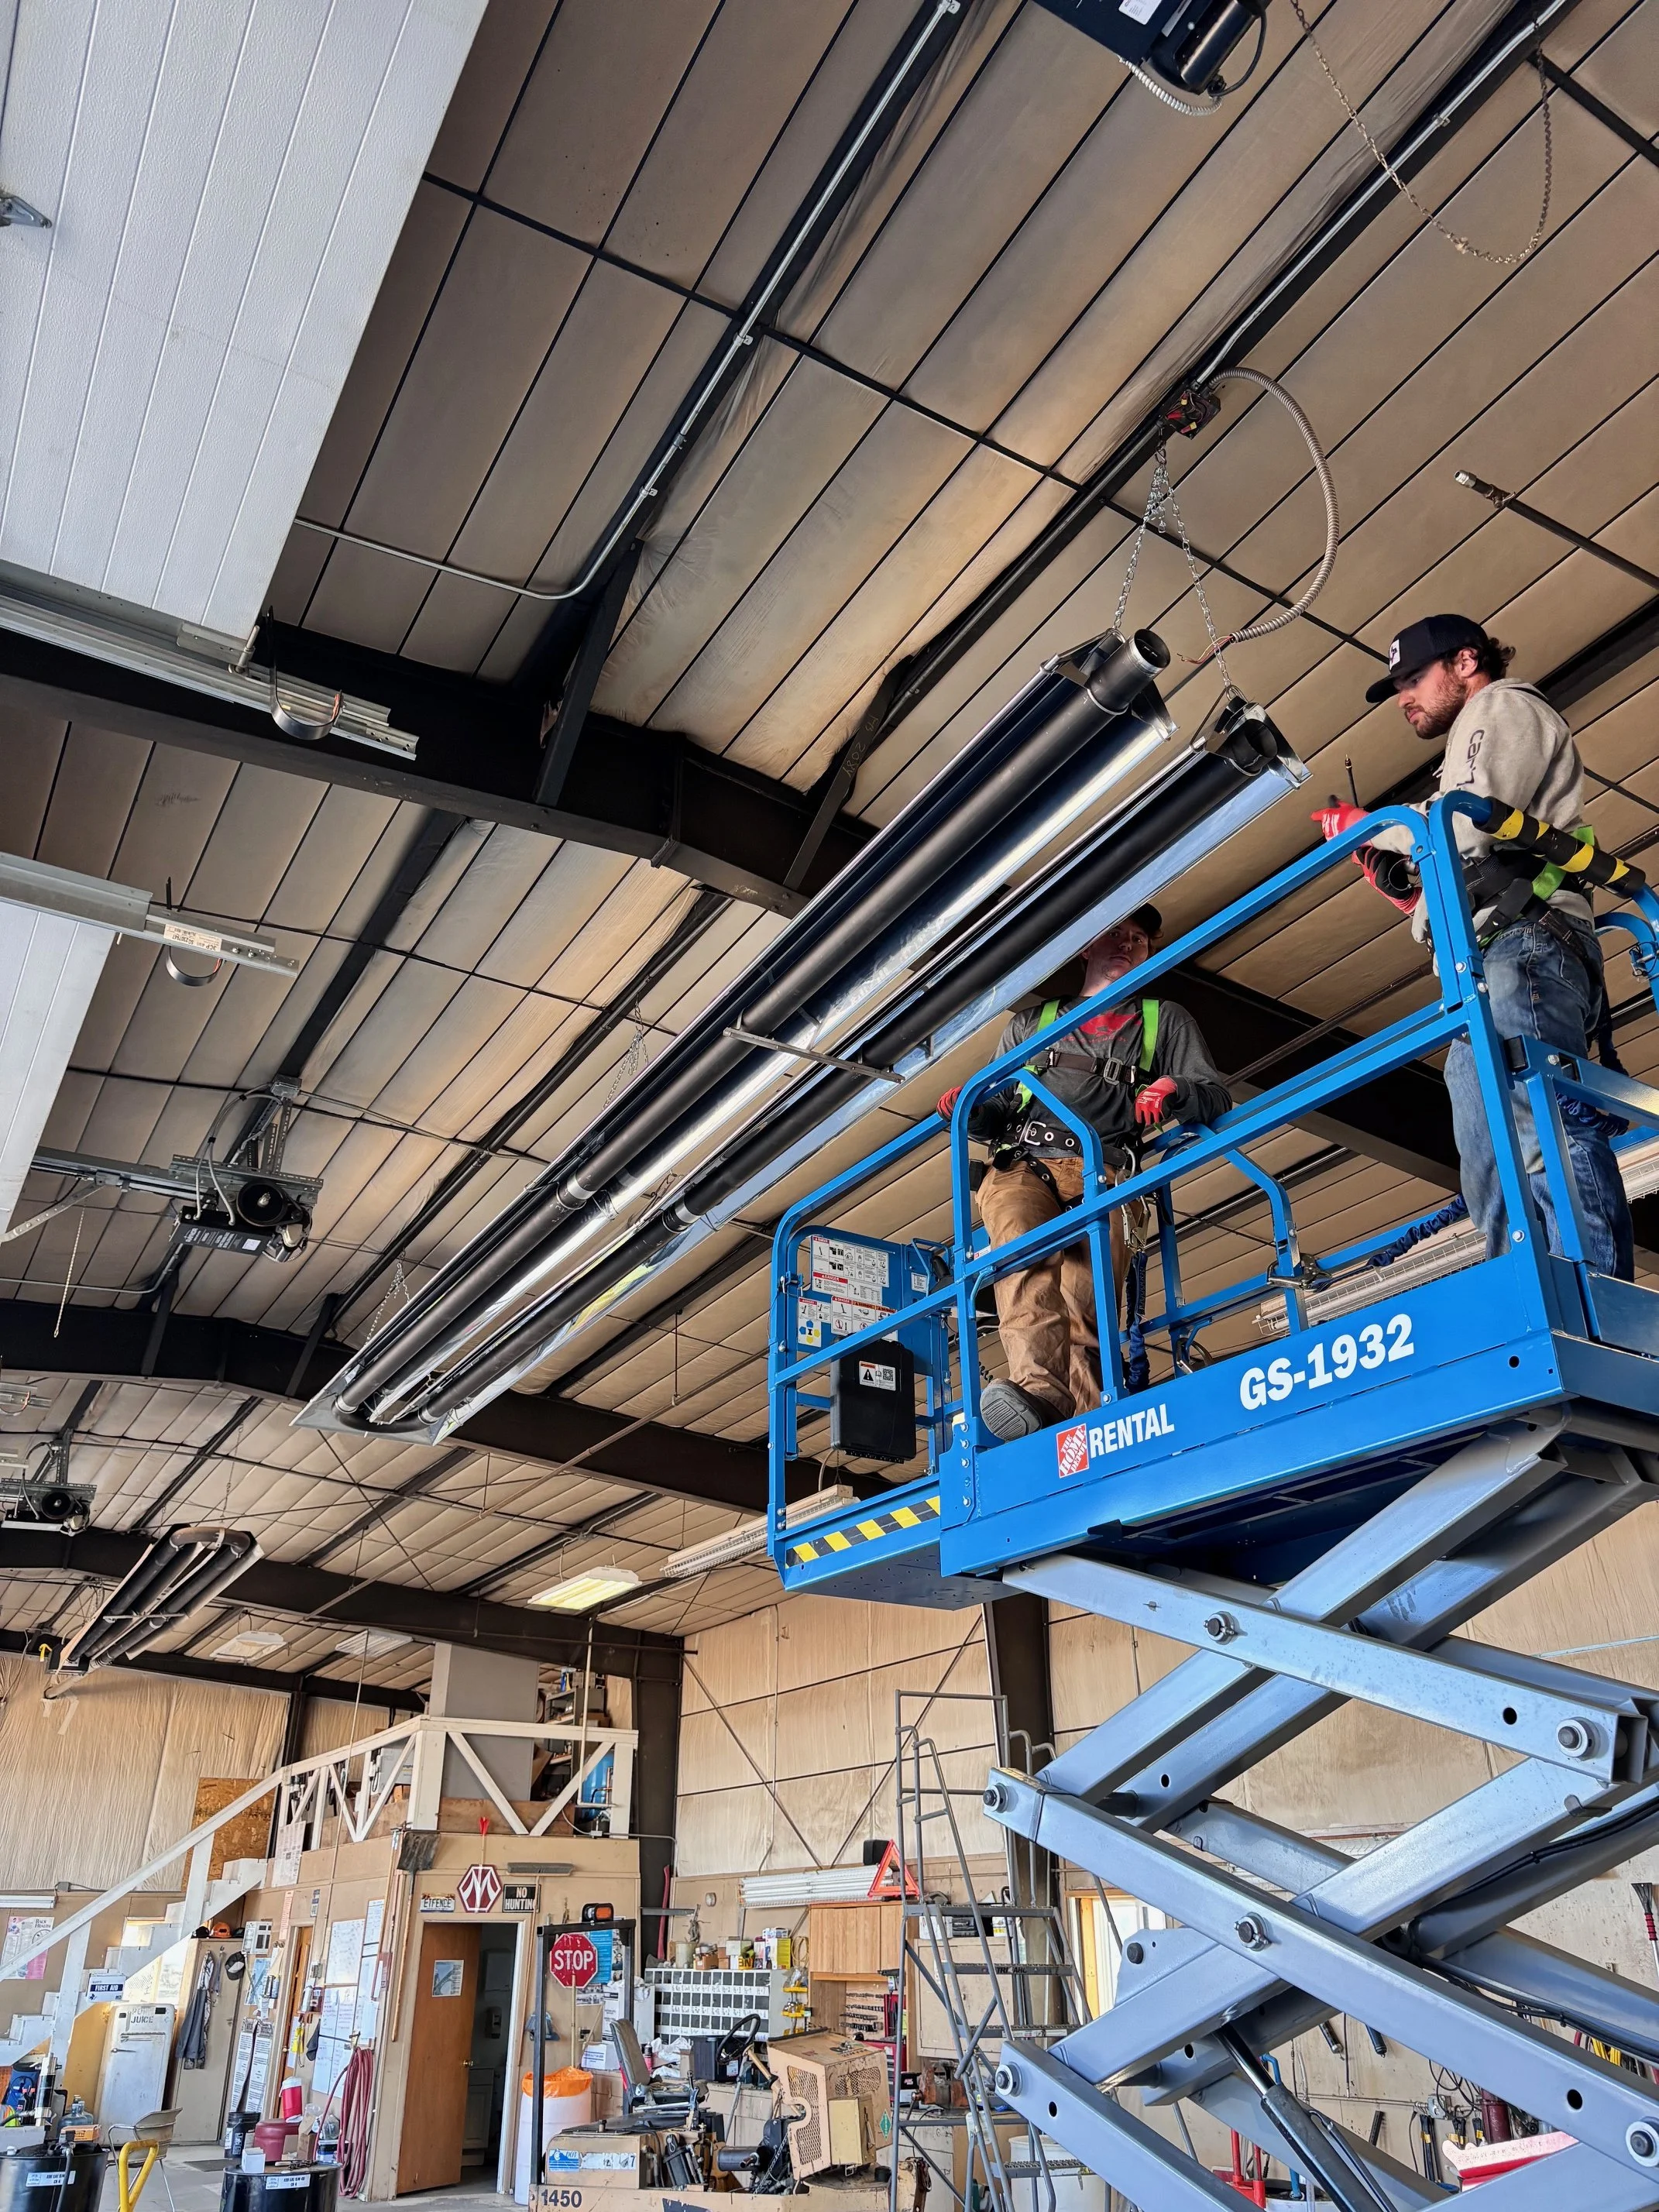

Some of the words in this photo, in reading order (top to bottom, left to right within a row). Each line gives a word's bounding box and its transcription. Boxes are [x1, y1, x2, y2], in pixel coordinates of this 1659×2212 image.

[1240, 1314, 1414, 1410] GS-1932
[1088, 1403, 1175, 1458] RENTAL
[1059, 1425, 1087, 1475] HOME
[1060, 1434, 1073, 1453] THE
[1070, 1442, 1087, 1472] DEPOT
[516, 1887, 527, 1898] NO
[554, 1949, 594, 1970] STOP
[541, 2189, 582, 2208] 1450
